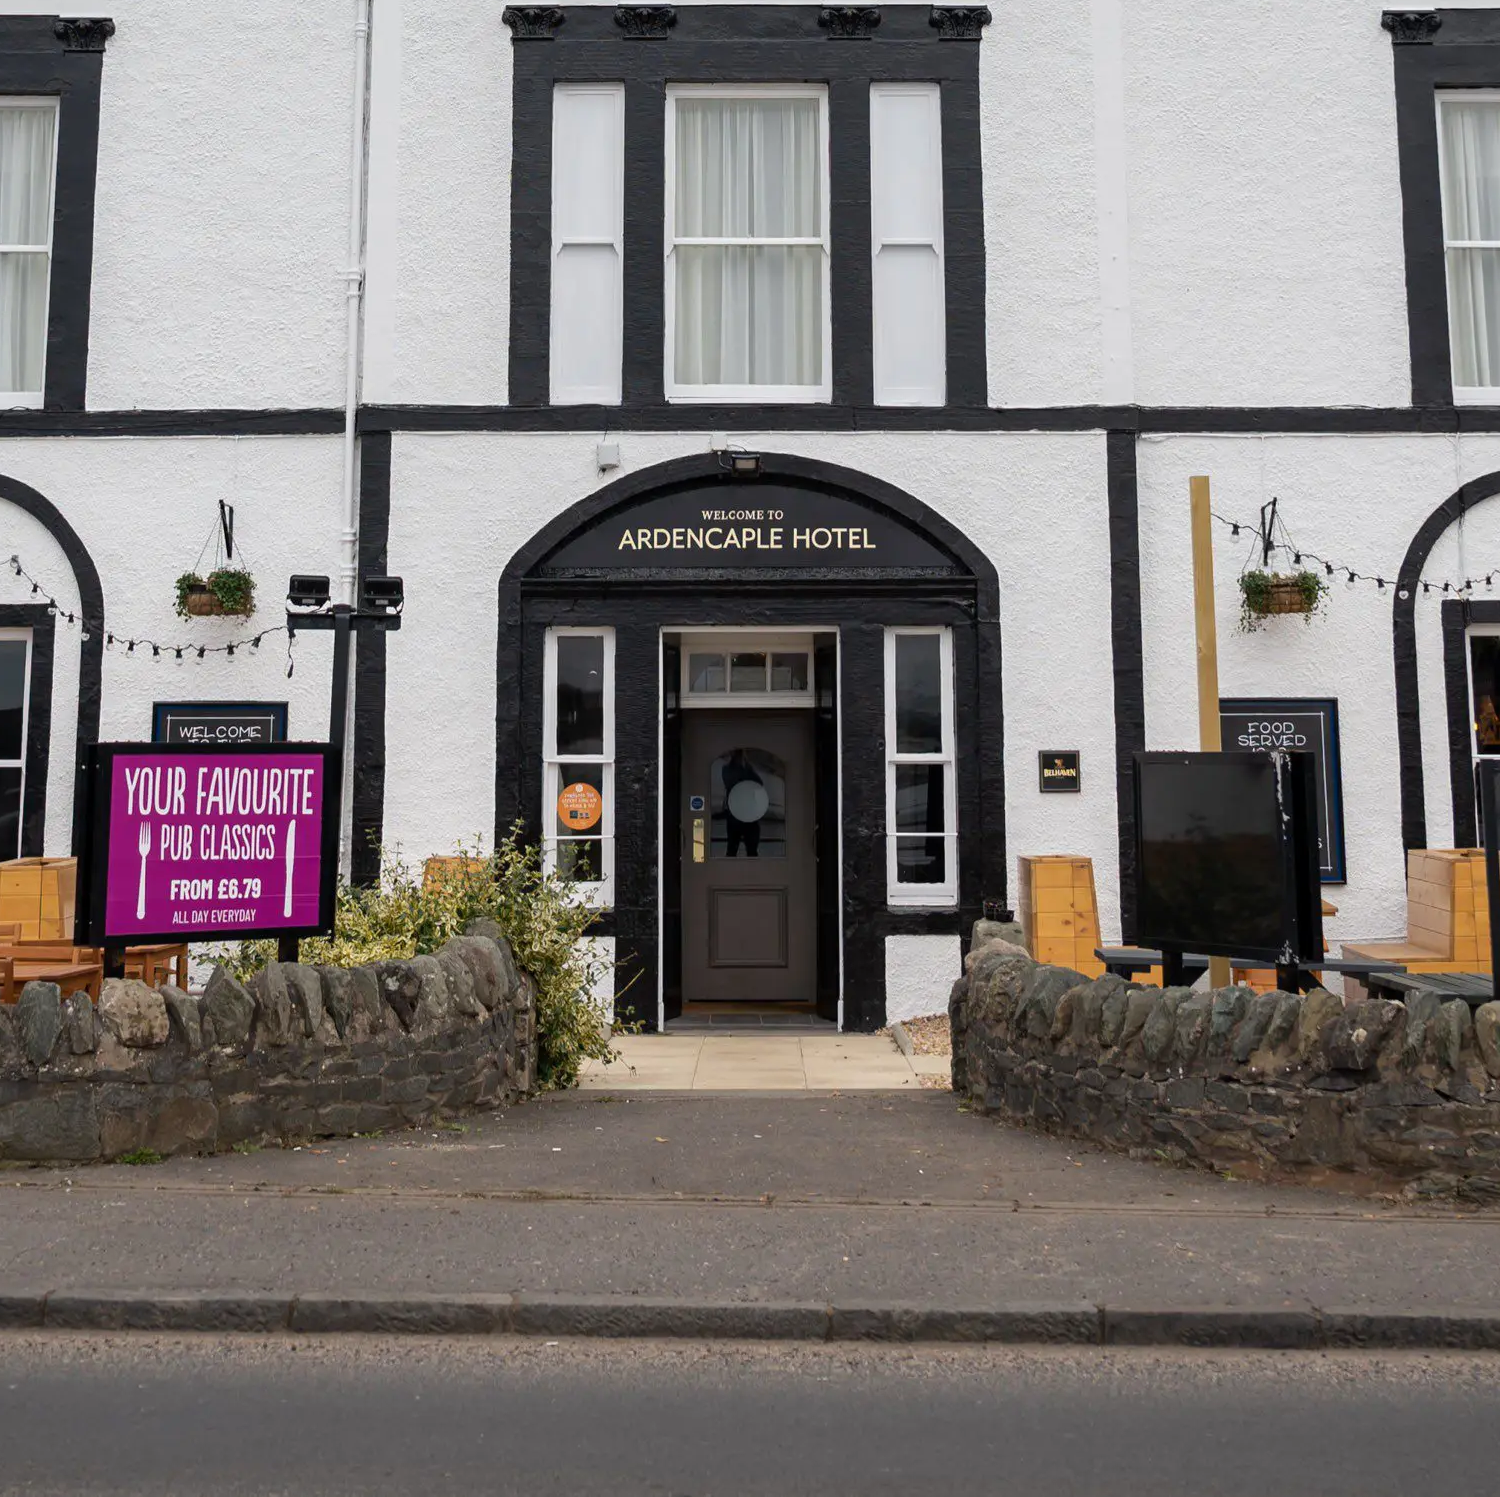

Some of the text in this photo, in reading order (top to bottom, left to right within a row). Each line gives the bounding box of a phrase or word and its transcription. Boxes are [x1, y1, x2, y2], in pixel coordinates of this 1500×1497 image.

[701, 510, 784, 520] WELCOME TO
[618, 527, 876, 550] ARDENCAPLE HOTEL
[179, 726, 262, 738] WELCOME
[1247, 722, 1295, 734] FOOD
[1237, 734, 1307, 747] SERVED
[125, 766, 315, 815] YOUR FAVOURITE
[160, 823, 276, 861] PUB CLASSICS
[170, 877, 262, 900] FROM £6.79
[172, 908, 256, 924] ALL DAY EVERYDAY
